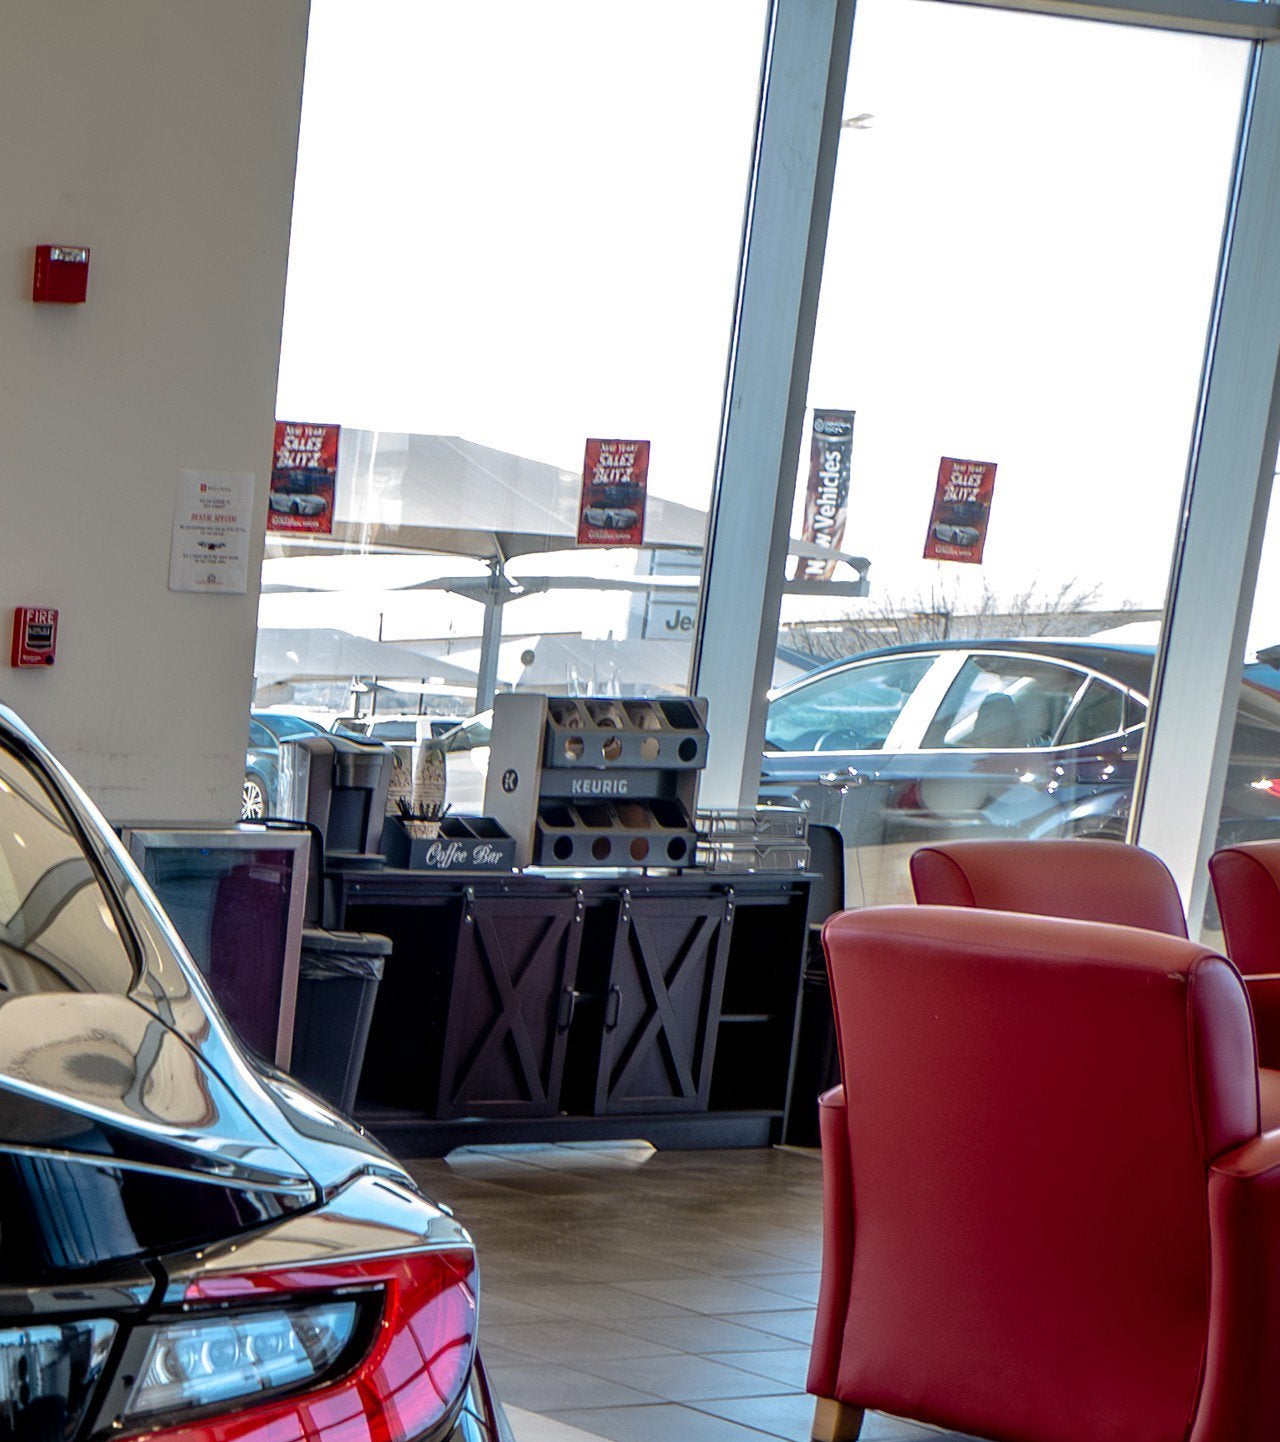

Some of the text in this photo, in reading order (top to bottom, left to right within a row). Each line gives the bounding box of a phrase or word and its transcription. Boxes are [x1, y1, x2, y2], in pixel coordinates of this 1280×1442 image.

[284, 435, 322, 451] SALES
[277, 450, 321, 468] BLITZ
[600, 452, 635, 467] SALES
[592, 466, 633, 484] BLITZ
[951, 472, 982, 487] SALES
[813, 450, 841, 529] Vehicles
[943, 486, 980, 502] BLITZ
[26, 609, 55, 624] FIRE
[665, 609, 695, 631] Je
[572, 778, 628, 794] KEURIG
[425, 841, 504, 869] Coffee Bar
